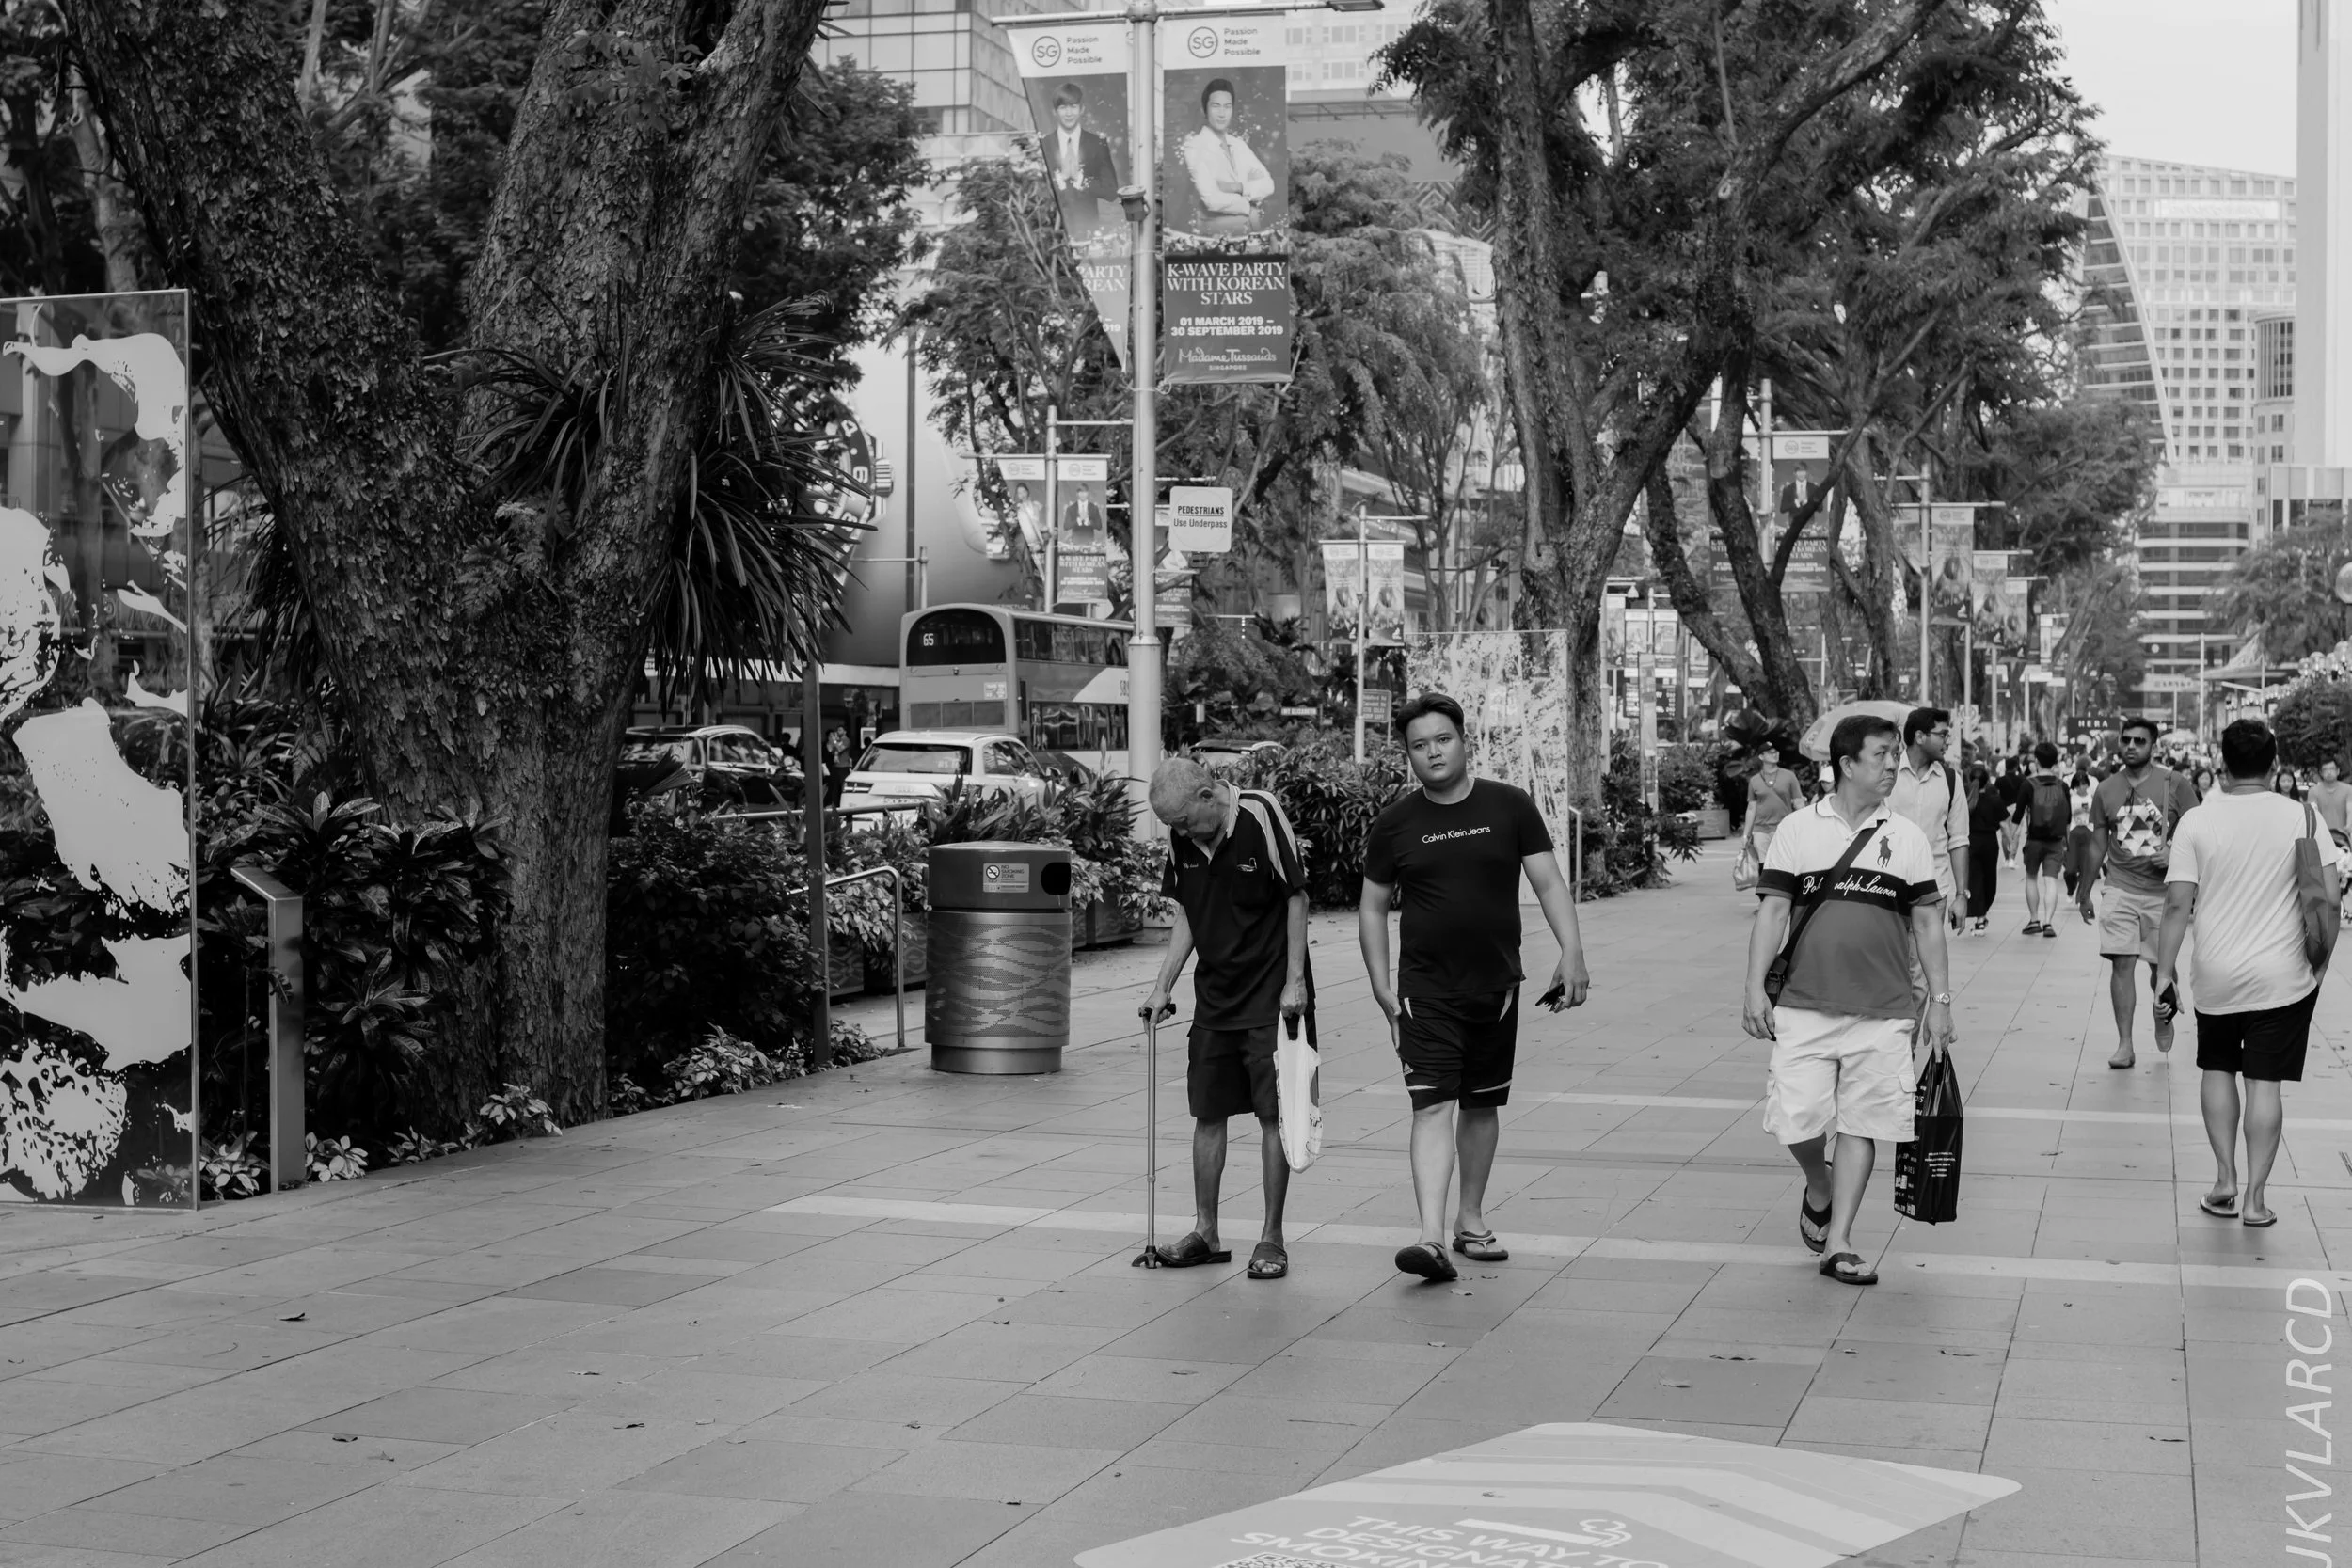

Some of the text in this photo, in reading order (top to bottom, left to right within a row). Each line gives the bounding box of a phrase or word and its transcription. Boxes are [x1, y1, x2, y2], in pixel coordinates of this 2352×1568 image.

[1224, 27, 1259, 36] Passion
[1192, 36, 1215, 50] SG
[1037, 45, 1057, 58] SG
[1168, 261, 1286, 277] K-WAVE PARTY
[1082, 277, 1125, 291] REAN
[1167, 277, 1285, 291] WITH KOREAN
[1200, 291, 1253, 305] STARS
[1103, 323, 1120, 332] 019
[1179, 317, 1193, 326] 01
[1195, 316, 1235, 326] MARCH
[1238, 316, 1264, 325] 2019
[1170, 325, 1284, 337] 30 SEPTEMBER 2019
[1178, 347, 1277, 363] Madame Tussauds
[1178, 505, 1224, 515] PEDESTRIANS
[1173, 518, 1228, 530] Use Underpass
[923, 633, 934, 646] 65
[2078, 720, 2108, 728] HERA
[1422, 826, 1491, 844] Calvin Klein Jeans
[1834, 874, 1863, 896] alph
[1347, 1516, 1465, 1541] THIS
[1468, 1535, 1590, 1560] WAY
[1230, 1533, 1458, 1568] SMOKIN
[1303, 1528, 1581, 1568] DESIGNAT
